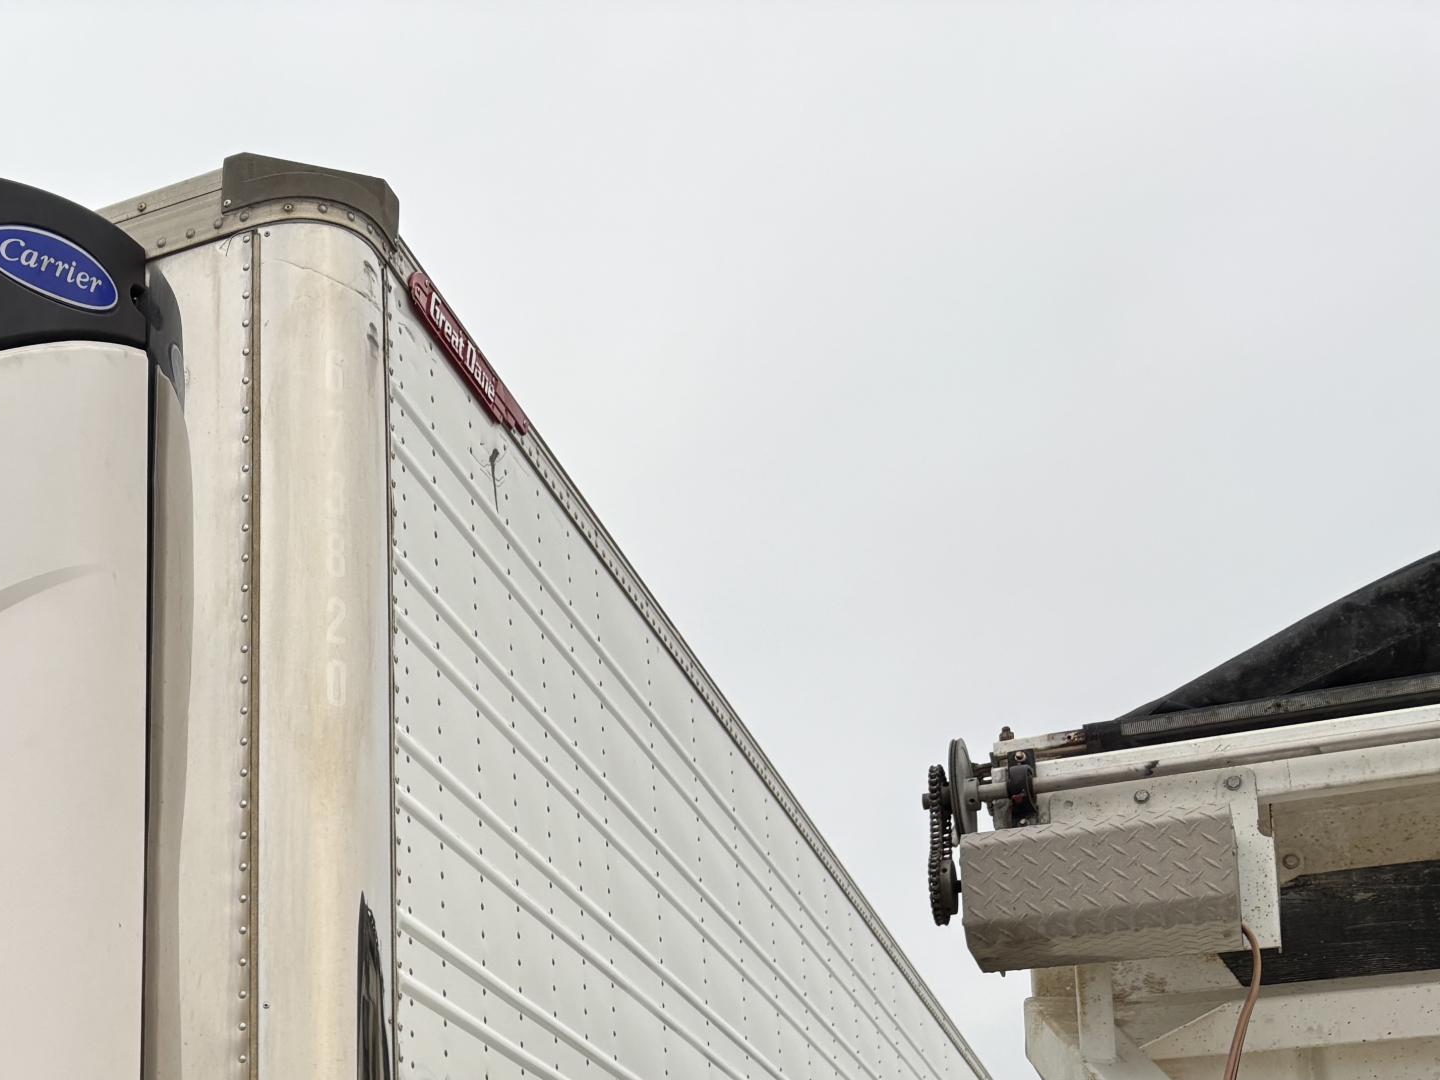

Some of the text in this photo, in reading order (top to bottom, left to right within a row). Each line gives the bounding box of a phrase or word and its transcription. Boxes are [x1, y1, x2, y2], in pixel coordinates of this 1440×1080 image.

[0, 238, 102, 293] Carrier
[430, 291, 496, 402] Great Dane
